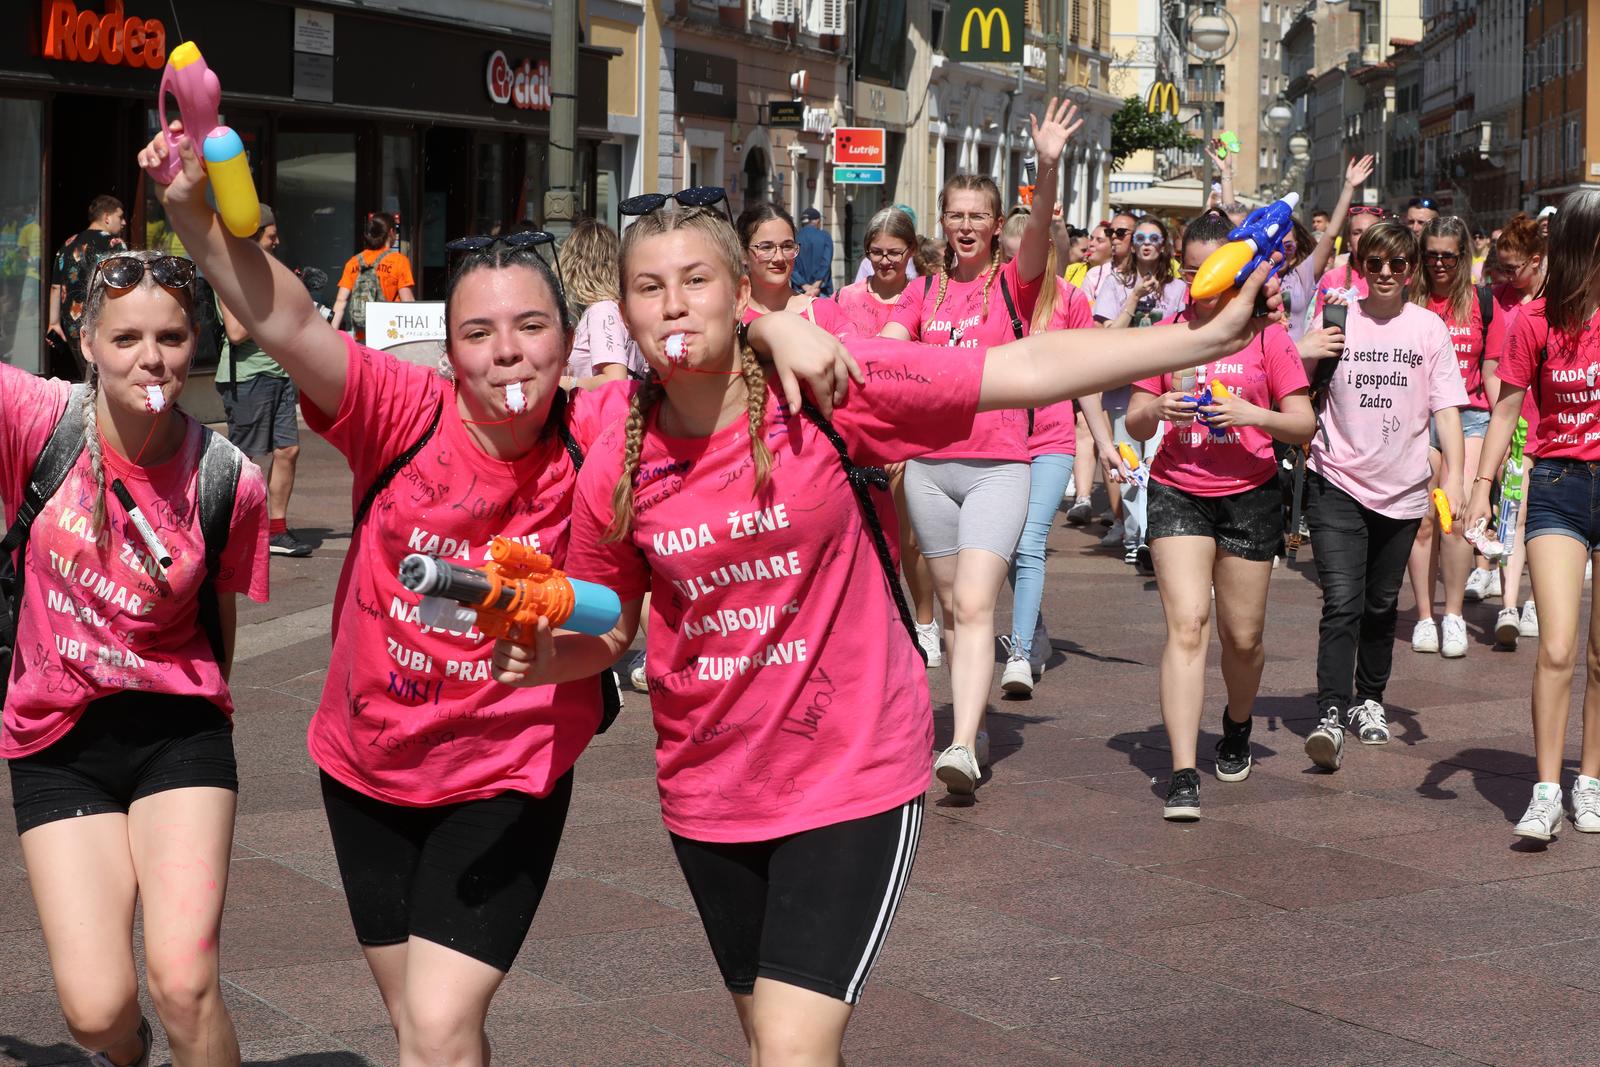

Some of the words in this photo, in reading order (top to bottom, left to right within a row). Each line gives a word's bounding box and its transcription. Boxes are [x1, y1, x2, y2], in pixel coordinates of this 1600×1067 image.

[44, 0, 166, 69] Rodea
[848, 145, 880, 156] Lutrija
[395, 315, 429, 329] THAI
[927, 320, 952, 332] ADA
[1214, 361, 1244, 375] ŽENE
[1353, 349, 1389, 362] sestre
[1393, 348, 1424, 369] Helge
[1347, 370, 1352, 385] i
[1355, 371, 1408, 389] gospodin
[1552, 368, 1587, 383] KADA
[1359, 393, 1393, 409] Zadro
[1554, 390, 1600, 403] TULUM
[652, 523, 716, 556] KADA
[727, 503, 791, 540] ŽENE
[407, 526, 470, 561] KADA
[684, 605, 776, 640] NAJBOLJI
[53, 633, 87, 662] UBI
[739, 638, 807, 676] PRAVE
[387, 636, 433, 674] ZUBI
[445, 659, 493, 682] PRA
